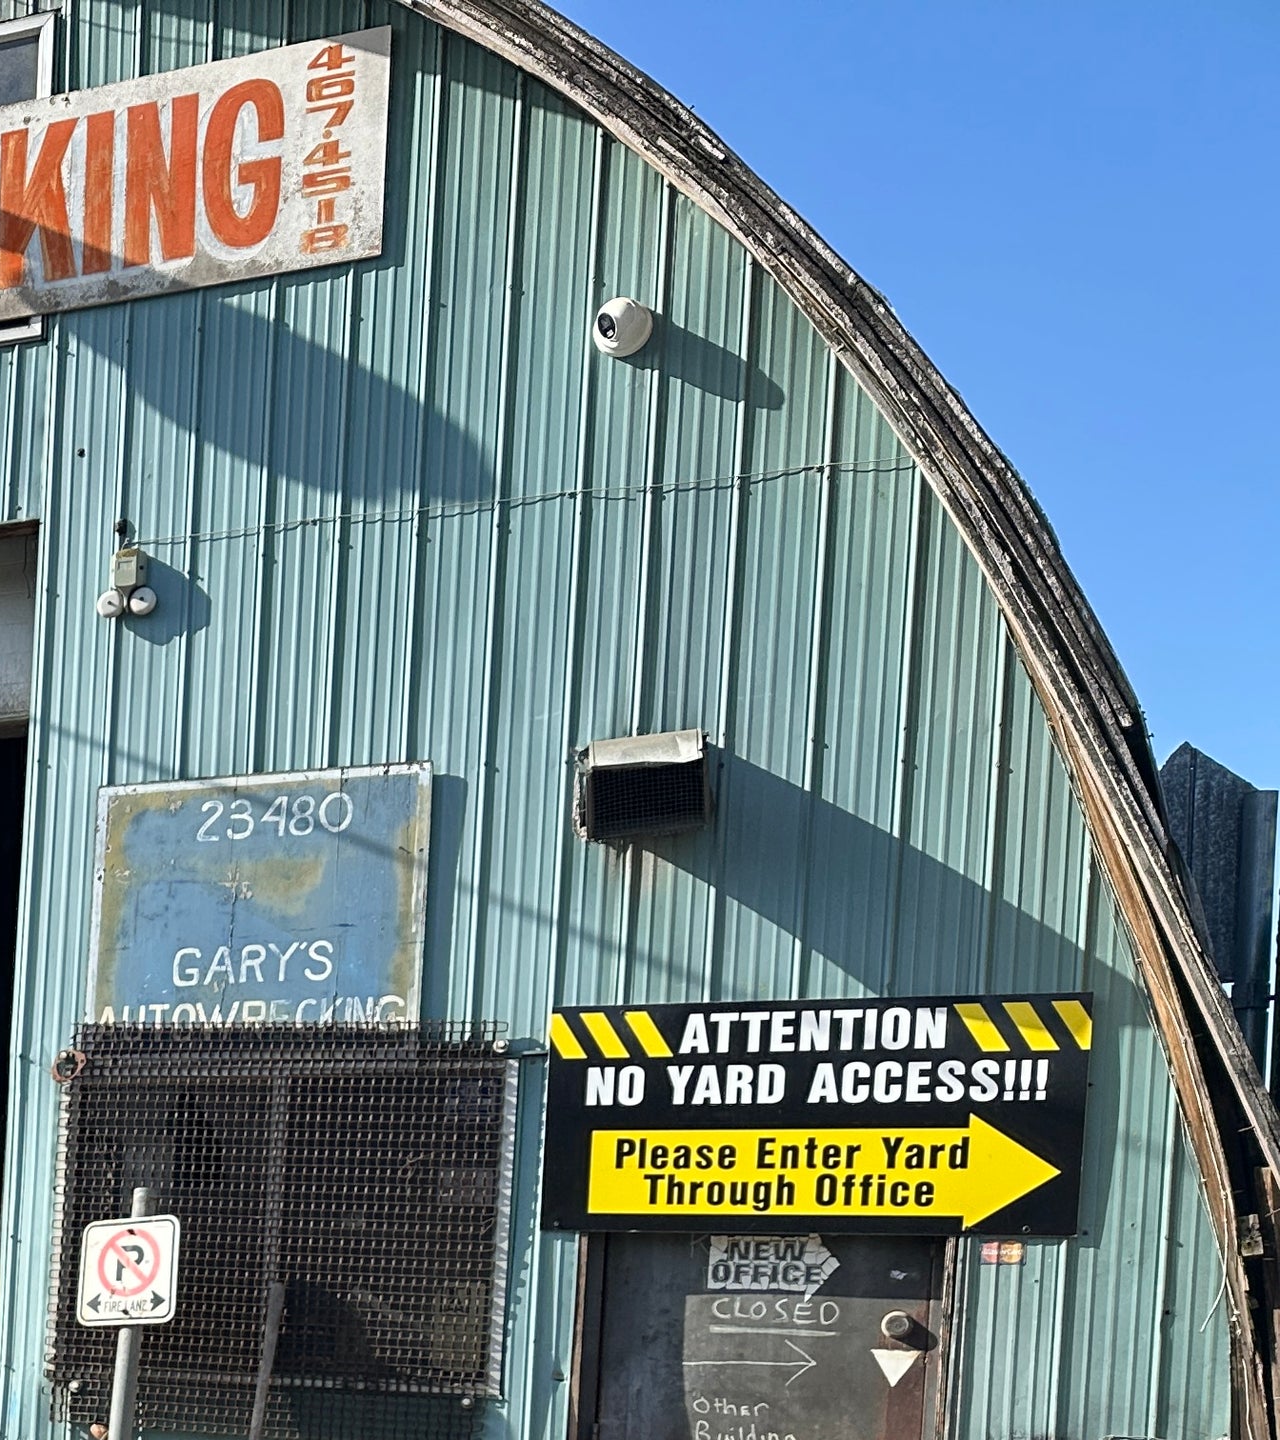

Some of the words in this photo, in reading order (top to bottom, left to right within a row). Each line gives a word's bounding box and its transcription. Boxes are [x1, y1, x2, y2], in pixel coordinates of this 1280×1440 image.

[197, 792, 353, 841] 23480
[172, 940, 334, 987] GARY'S
[679, 1006, 947, 1055] ATTENTION
[586, 1066, 645, 1106] NO
[667, 1064, 785, 1105] YARD
[807, 1059, 1049, 1103] ACCESS!!!
[616, 1138, 737, 1170] Please
[757, 1137, 861, 1170] Enter
[882, 1136, 970, 1169] Yard
[644, 1174, 795, 1211] Through
[815, 1175, 935, 1207] Office
[728, 1239, 805, 1261] NEW
[711, 1260, 822, 1286] OFFICE
[712, 1297, 839, 1325] CLOSED
